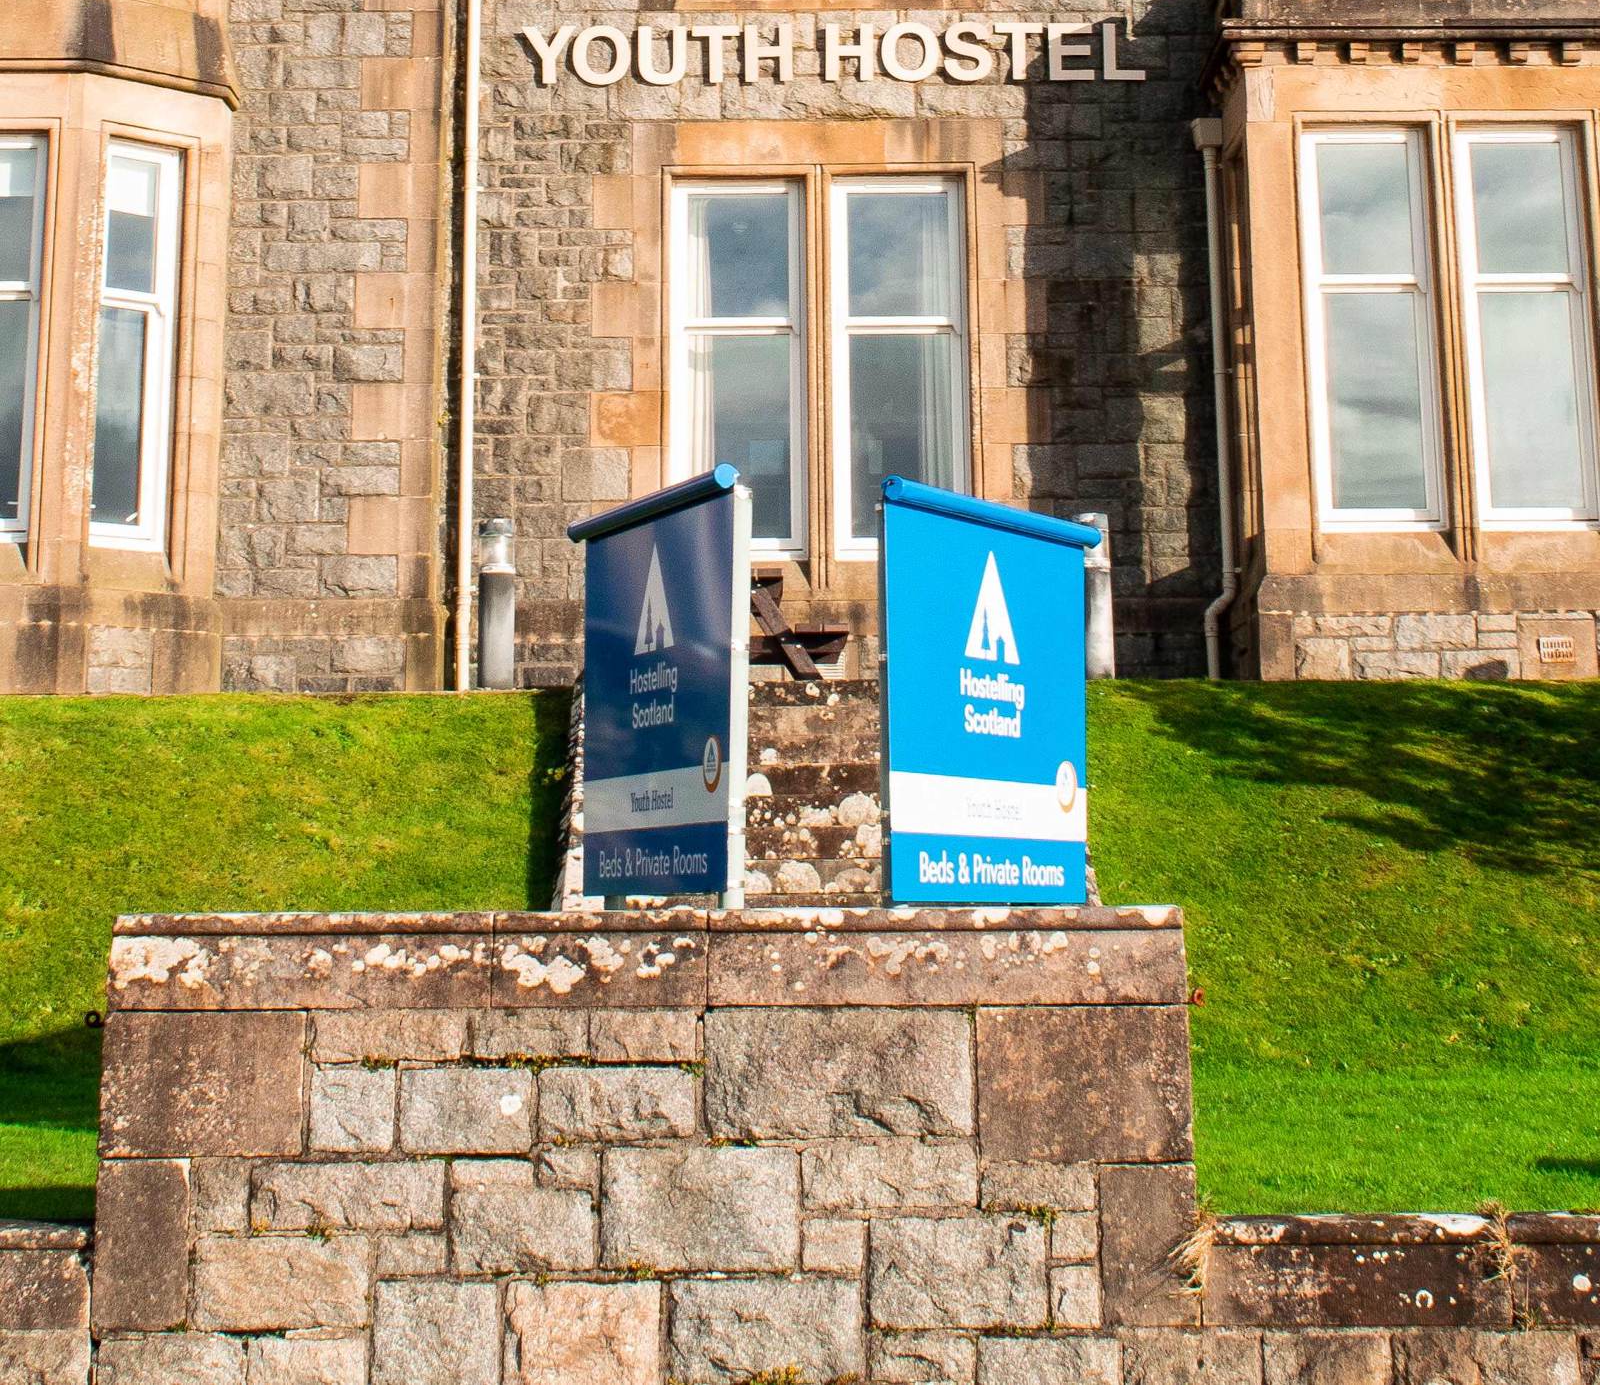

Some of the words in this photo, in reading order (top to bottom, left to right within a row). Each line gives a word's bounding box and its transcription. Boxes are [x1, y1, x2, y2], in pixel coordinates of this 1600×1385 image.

[521, 23, 794, 85] YOUTH
[824, 20, 1146, 82] HOSTEL
[630, 661, 678, 695] Hostelling
[960, 667, 1025, 710] Hostelling
[632, 695, 674, 729] Scotland
[964, 703, 1021, 738] Scotland
[630, 790, 650, 813] Youth
[651, 787, 674, 810] Hostel
[599, 846, 622, 878] Beds
[625, 847, 633, 877] &
[635, 847, 671, 876] Private
[673, 845, 708, 875] Rooms
[919, 849, 955, 884] Beds
[958, 852, 971, 884] &
[972, 853, 1020, 886] Private
[1022, 855, 1065, 887] Rooms
